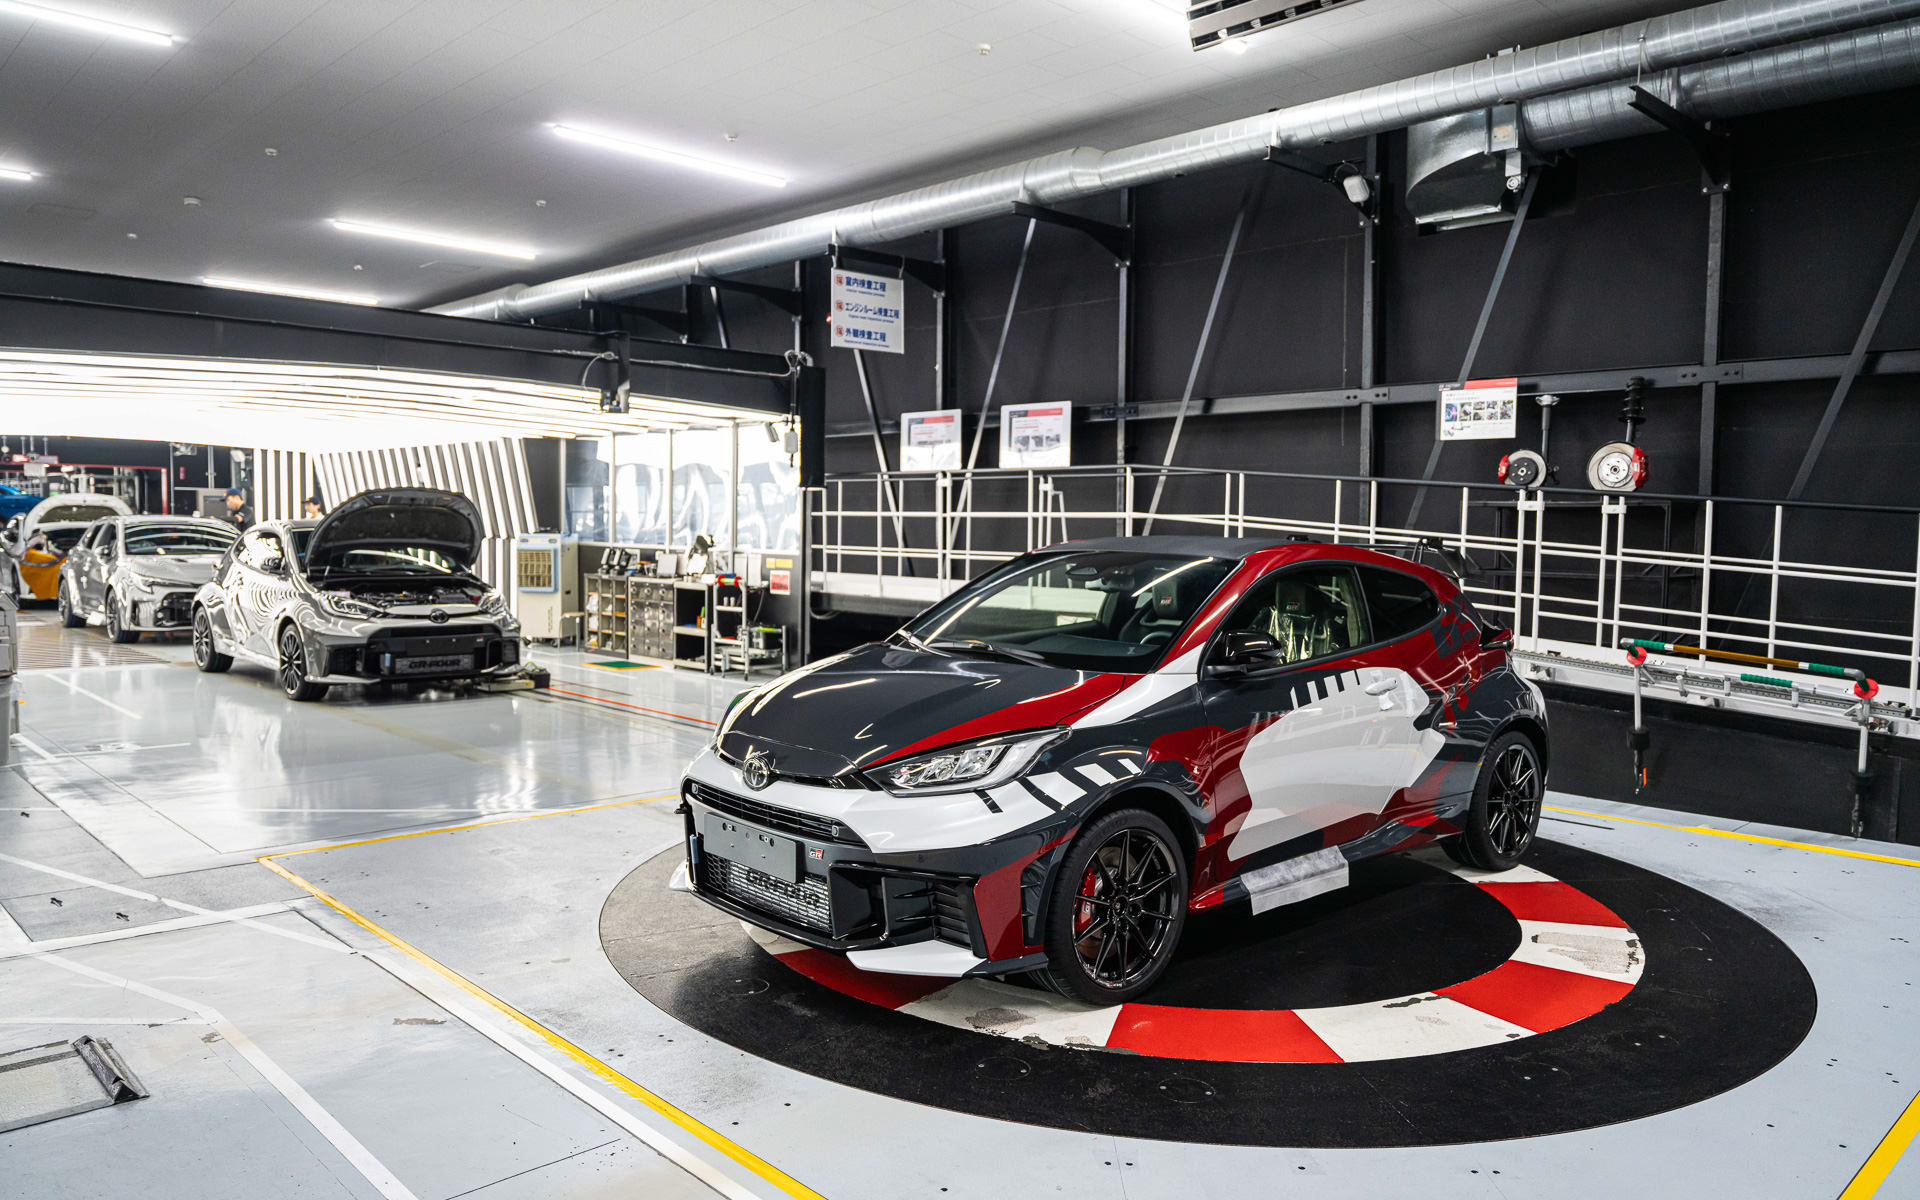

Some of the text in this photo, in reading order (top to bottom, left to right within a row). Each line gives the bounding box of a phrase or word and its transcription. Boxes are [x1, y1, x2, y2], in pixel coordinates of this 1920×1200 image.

[845, 276, 887, 293] 室内検査工程
[845, 302, 900, 319] エンジンルーム検査工程
[845, 327, 887, 342] 外観検査工程
[809, 848, 823, 860] GR
